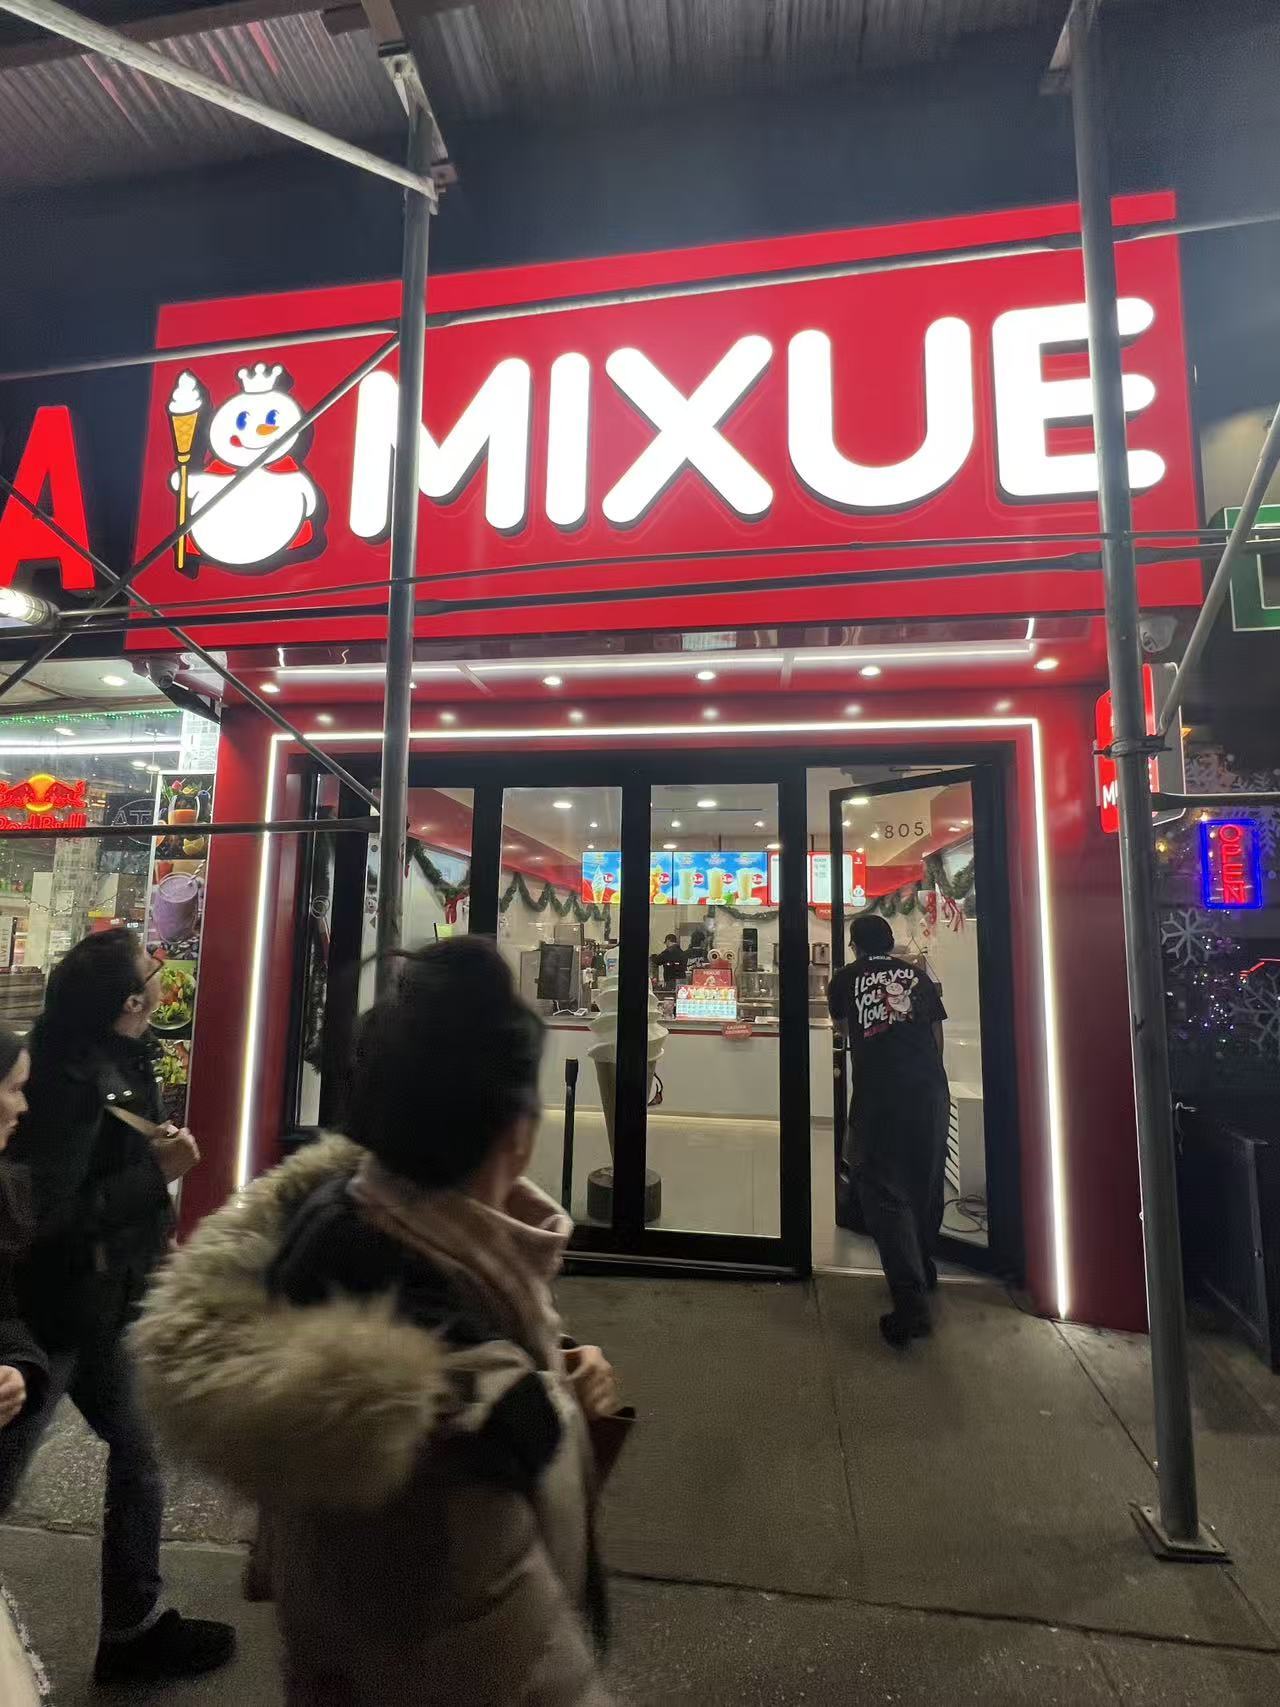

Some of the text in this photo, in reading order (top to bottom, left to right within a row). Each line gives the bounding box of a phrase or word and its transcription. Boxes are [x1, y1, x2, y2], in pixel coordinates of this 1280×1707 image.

[349, 297, 1168, 539] MIXUE
[111, 809, 153, 827] AT
[884, 822, 924, 839] 805
[1218, 824, 1247, 904] OPEN
[860, 971, 888, 993] LOVE
[888, 968, 914, 983] YOU
[855, 989, 882, 1024] YOU
[863, 1003, 889, 1029] LOVE
